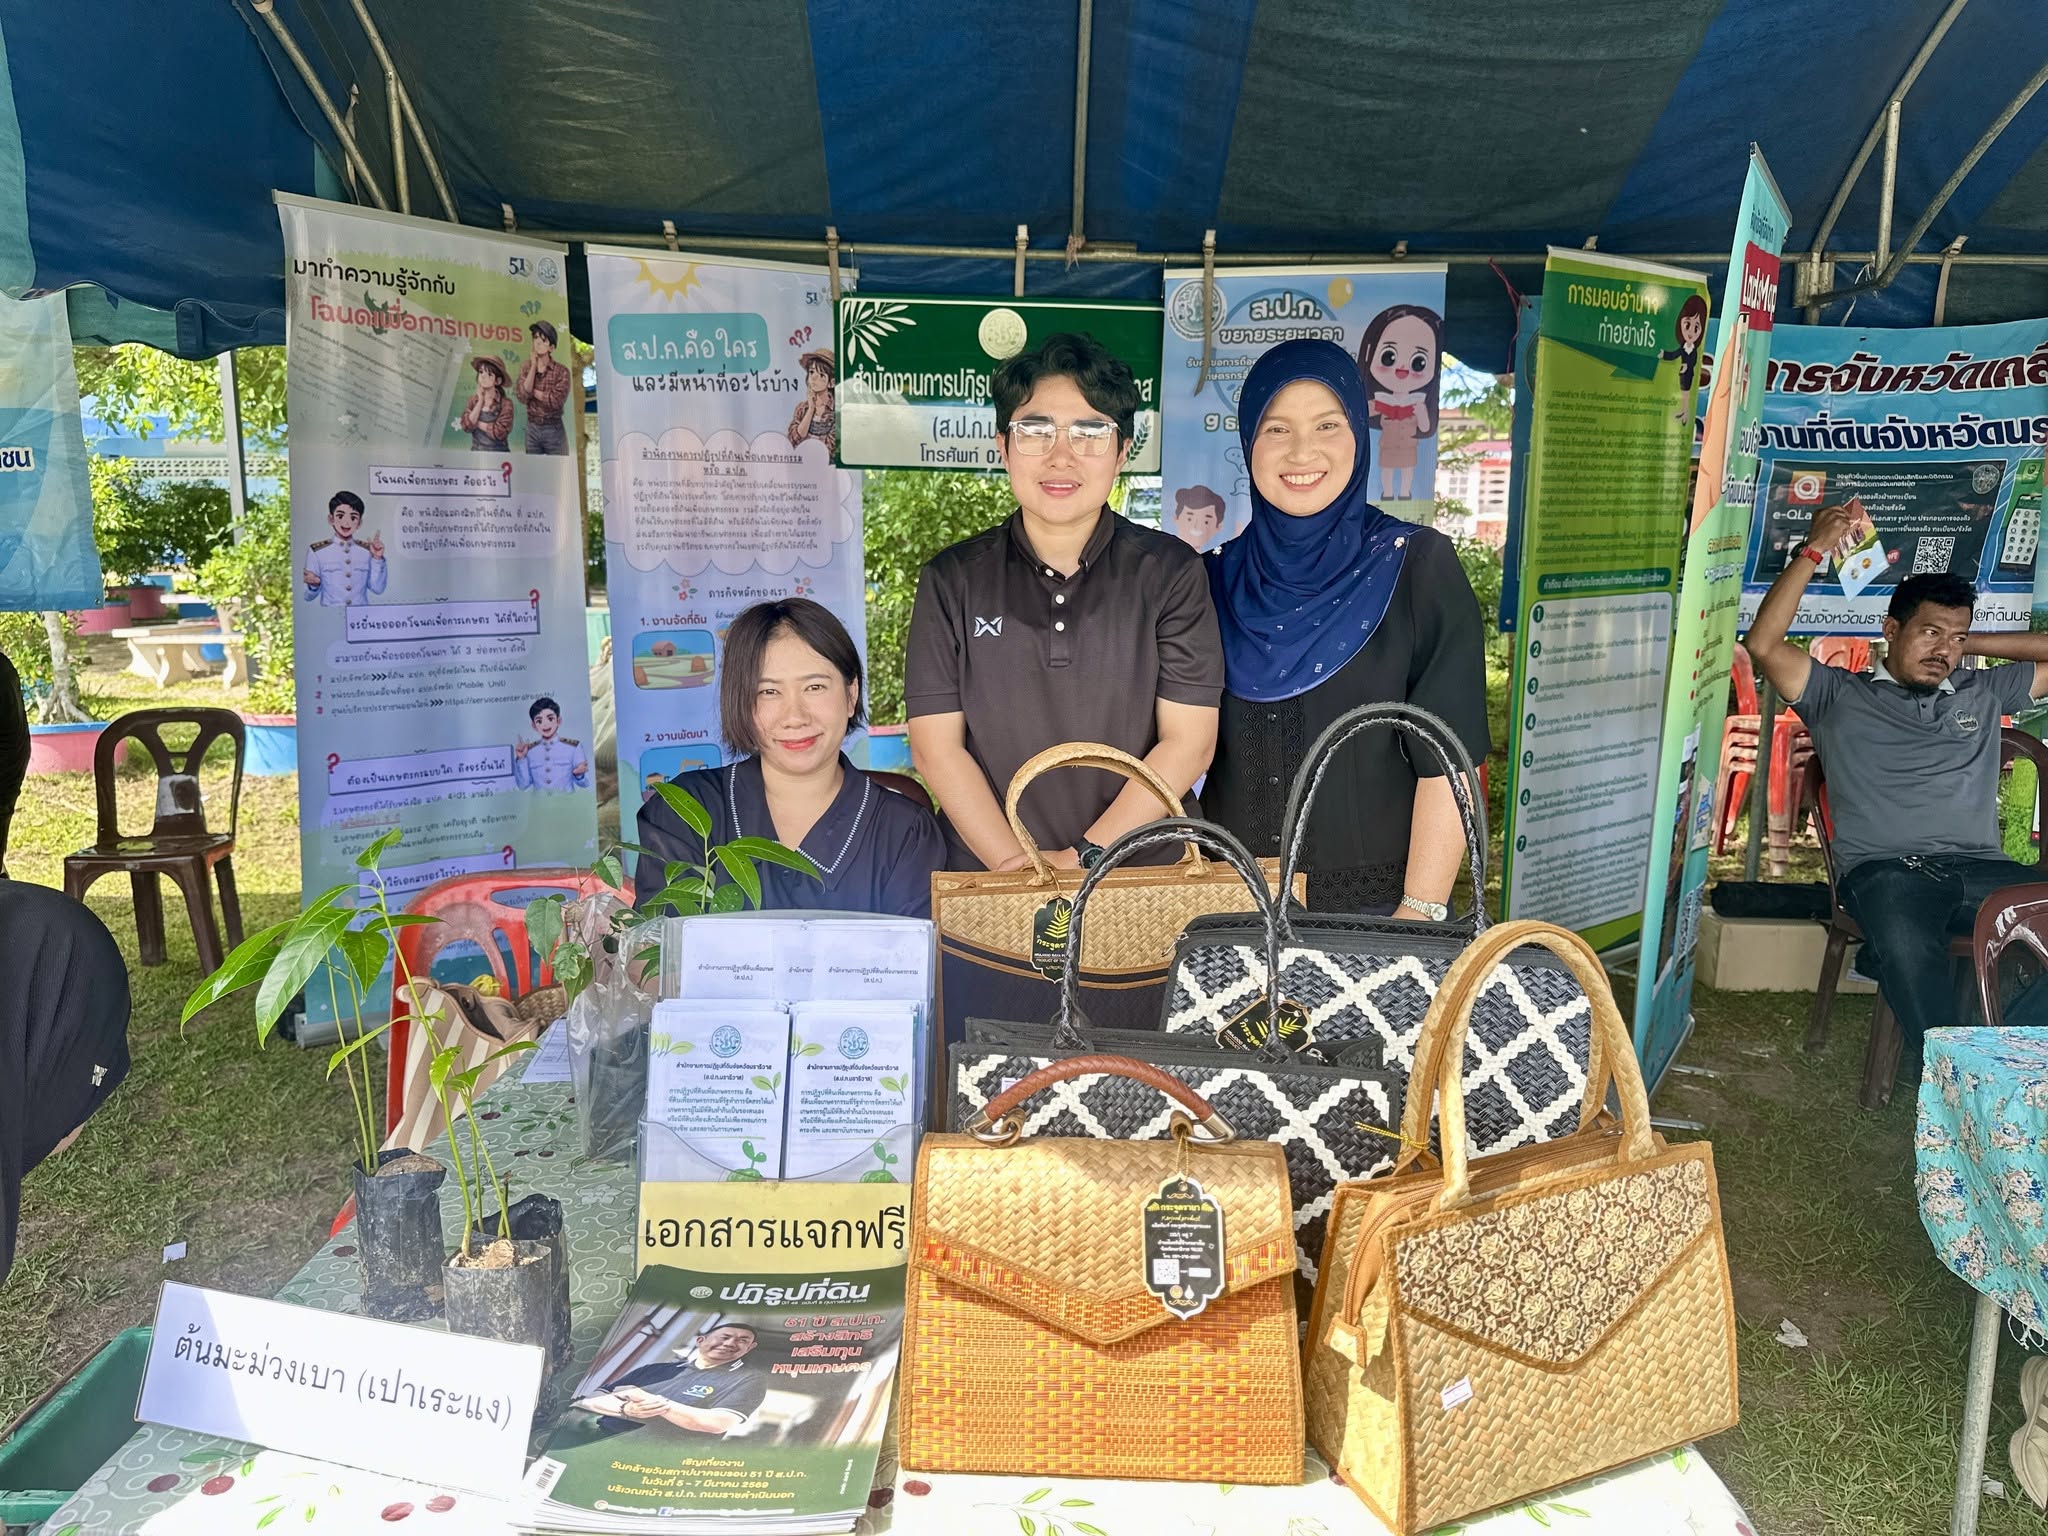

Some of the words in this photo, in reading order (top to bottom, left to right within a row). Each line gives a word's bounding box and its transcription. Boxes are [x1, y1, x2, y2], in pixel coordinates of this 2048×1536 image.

[293, 257, 456, 297] มาทำความรู้จักกับ
[1250, 291, 1323, 320] ส.ป.ก.
[1567, 282, 1660, 316] การมอบอำนาจ
[310, 294, 524, 344] โฉนดเพื่อการเกษตร
[1219, 326, 1344, 344] ขยายระยะเวลา
[1598, 320, 1656, 349] ทำอย่างไร
[622, 327, 758, 361] ส.ป.ก.คือใคร
[632, 363, 799, 393] และมีหน้าที่อะไรบ้าง
[0, 449, 32, 469] ชน
[920, 444, 979, 463] โทรศัพท์
[375, 471, 459, 487] โฉนดเพื่อการเกษตร
[463, 475, 497, 488] คืออะไร
[1773, 508, 1812, 521] e-QLa
[708, 585, 788, 599] ภารกิจหลักของเรา
[639, 616, 650, 626] 1.
[652, 610, 707, 626] งานจัดที่ดิน
[465, 646, 472, 655] 3
[644, 731, 655, 742] 2.
[656, 728, 709, 742] งานพัฒนา
[645, 1205, 906, 1250] เอกสารแจกฟรี
[719, 1277, 871, 1306] ปฏิรูปที่ดิน
[784, 1317, 807, 1328] 51
[813, 1315, 828, 1328] ปี
[791, 1345, 863, 1361] เสริมทุน
[174, 1322, 346, 1394] ต้นมะม่วงเบา
[357, 1368, 513, 1431] (เปาเระแง)
[771, 1361, 872, 1379] หนุนเกษตร
[681, 1456, 745, 1468] เชิญเที่ยวงาน
[749, 1470, 763, 1478] 51
[703, 1479, 740, 1488] มีนาคม
